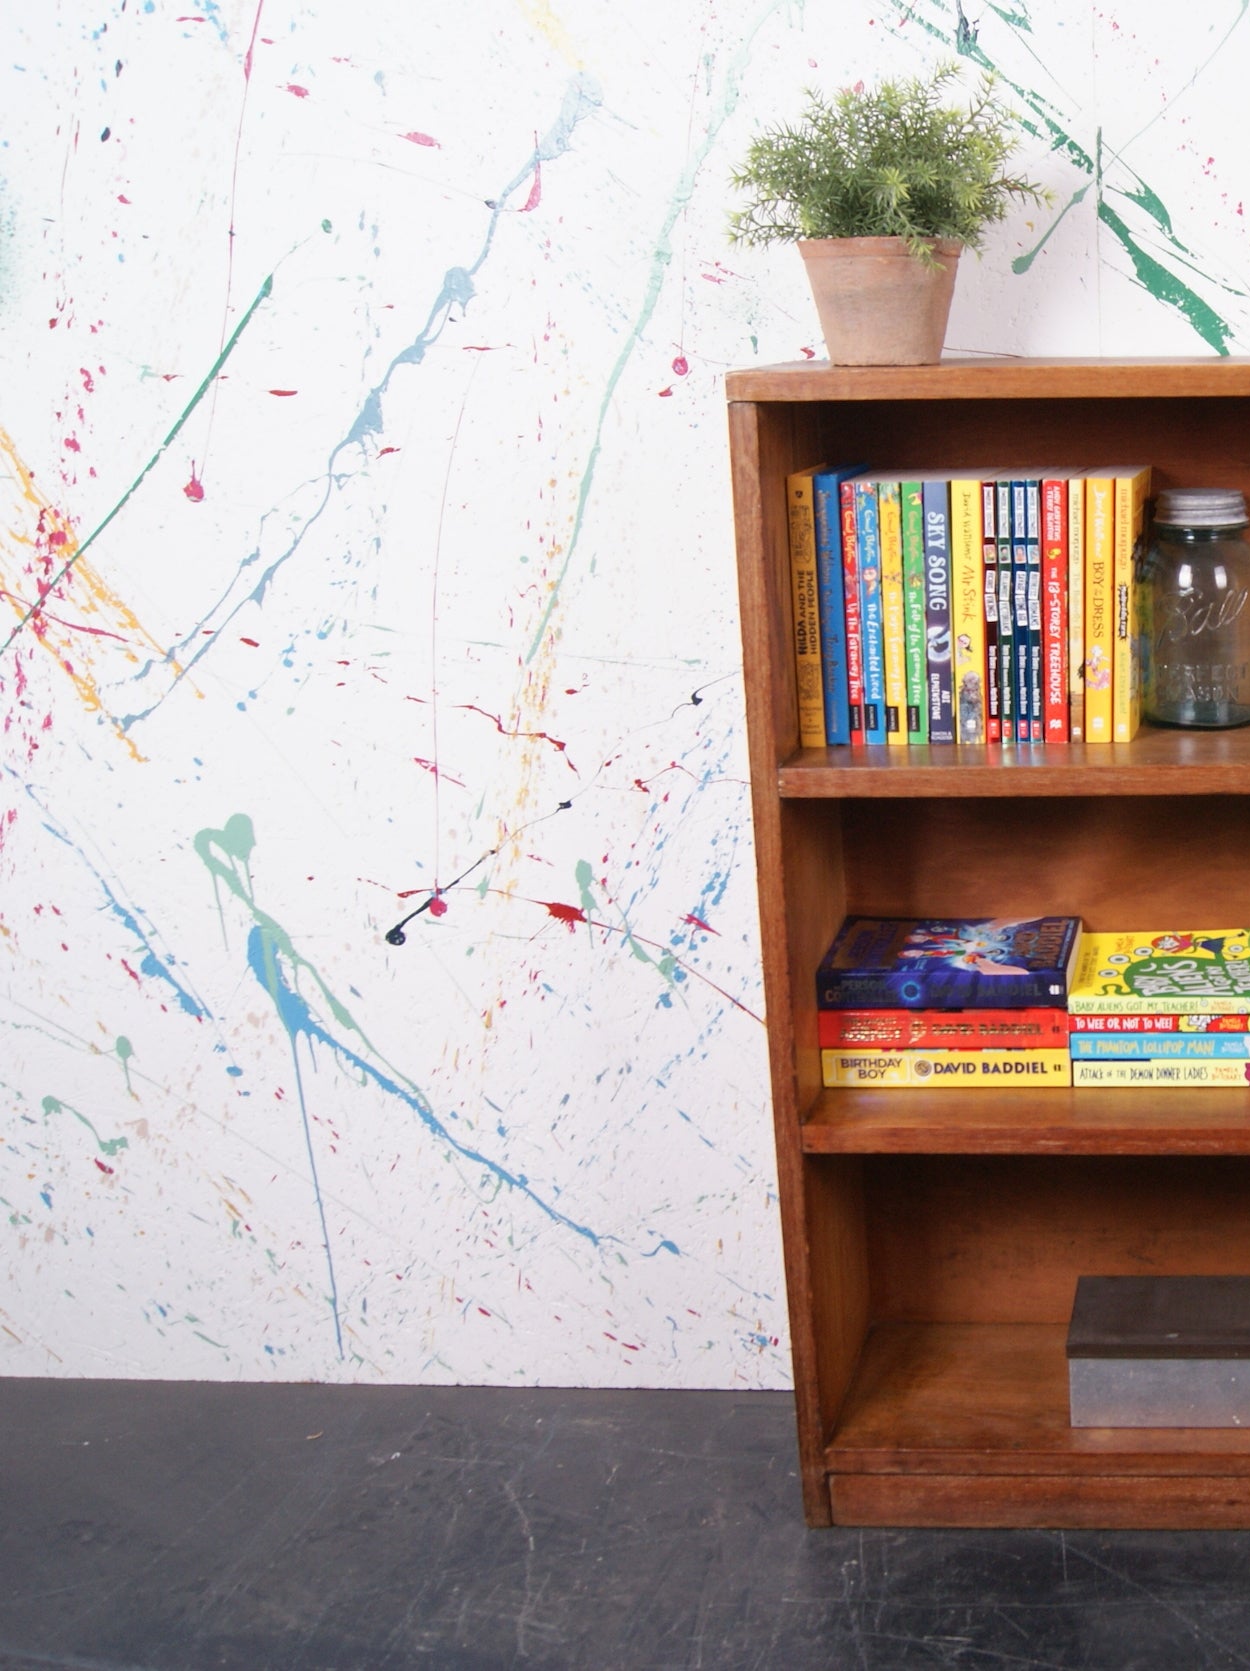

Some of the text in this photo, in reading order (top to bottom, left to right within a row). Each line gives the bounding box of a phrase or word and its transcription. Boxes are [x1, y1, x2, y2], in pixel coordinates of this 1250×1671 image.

[862, 509, 876, 564] Enid Blyton
[927, 511, 947, 611] SKY SONG
[1092, 561, 1105, 588] BOY
[961, 564, 977, 624] Mr Stink
[796, 569, 808, 655] HILDA AND THE
[806, 569, 817, 655] HIDDEN PEOPLE
[1048, 581, 1062, 639] 13-STOREY
[1092, 597, 1105, 638] DRESS
[1158, 586, 1249, 645] Ball
[847, 633, 860, 677] Faraway
[866, 620, 880, 672] Enchanted
[870, 673, 882, 700] Wood
[1049, 642, 1062, 705] TREEHOUSE
[850, 679, 861, 700] Tree
[912, 684, 922, 705] Tree
[930, 673, 941, 720] ELPHINSTONE
[978, 984, 1042, 997] BADDIEL
[1156, 960, 1235, 996] ALIENS
[1075, 1001, 1096, 1012] BABY
[1097, 1001, 1125, 1012] ALIENS
[1126, 1001, 1141, 1011] GOT
[1147, 1001, 1159, 1012] MY
[1162, 1001, 1198, 1012] TEACHER!
[932, 1023, 1044, 1036] DAVID BADDIEL
[1087, 1017, 1105, 1030] WEE
[1107, 1017, 1121, 1030] OR
[1123, 1017, 1140, 1030] NOT
[1154, 1017, 1173, 1030] WEE!
[1077, 1039, 1215, 1056] THE PHANTOM LOLLIPOP MAN!
[840, 1058, 903, 1069] BIRTHDAY
[858, 1069, 887, 1080] BOY
[933, 1062, 1048, 1075] DAVID BADDIEL
[1080, 1068, 1103, 1080] ATTACK
[1116, 1069, 1127, 1078] THE
[1130, 1067, 1153, 1080] DEMON
[1156, 1067, 1181, 1080] DINNER
[1184, 1066, 1209, 1080] LADIES
